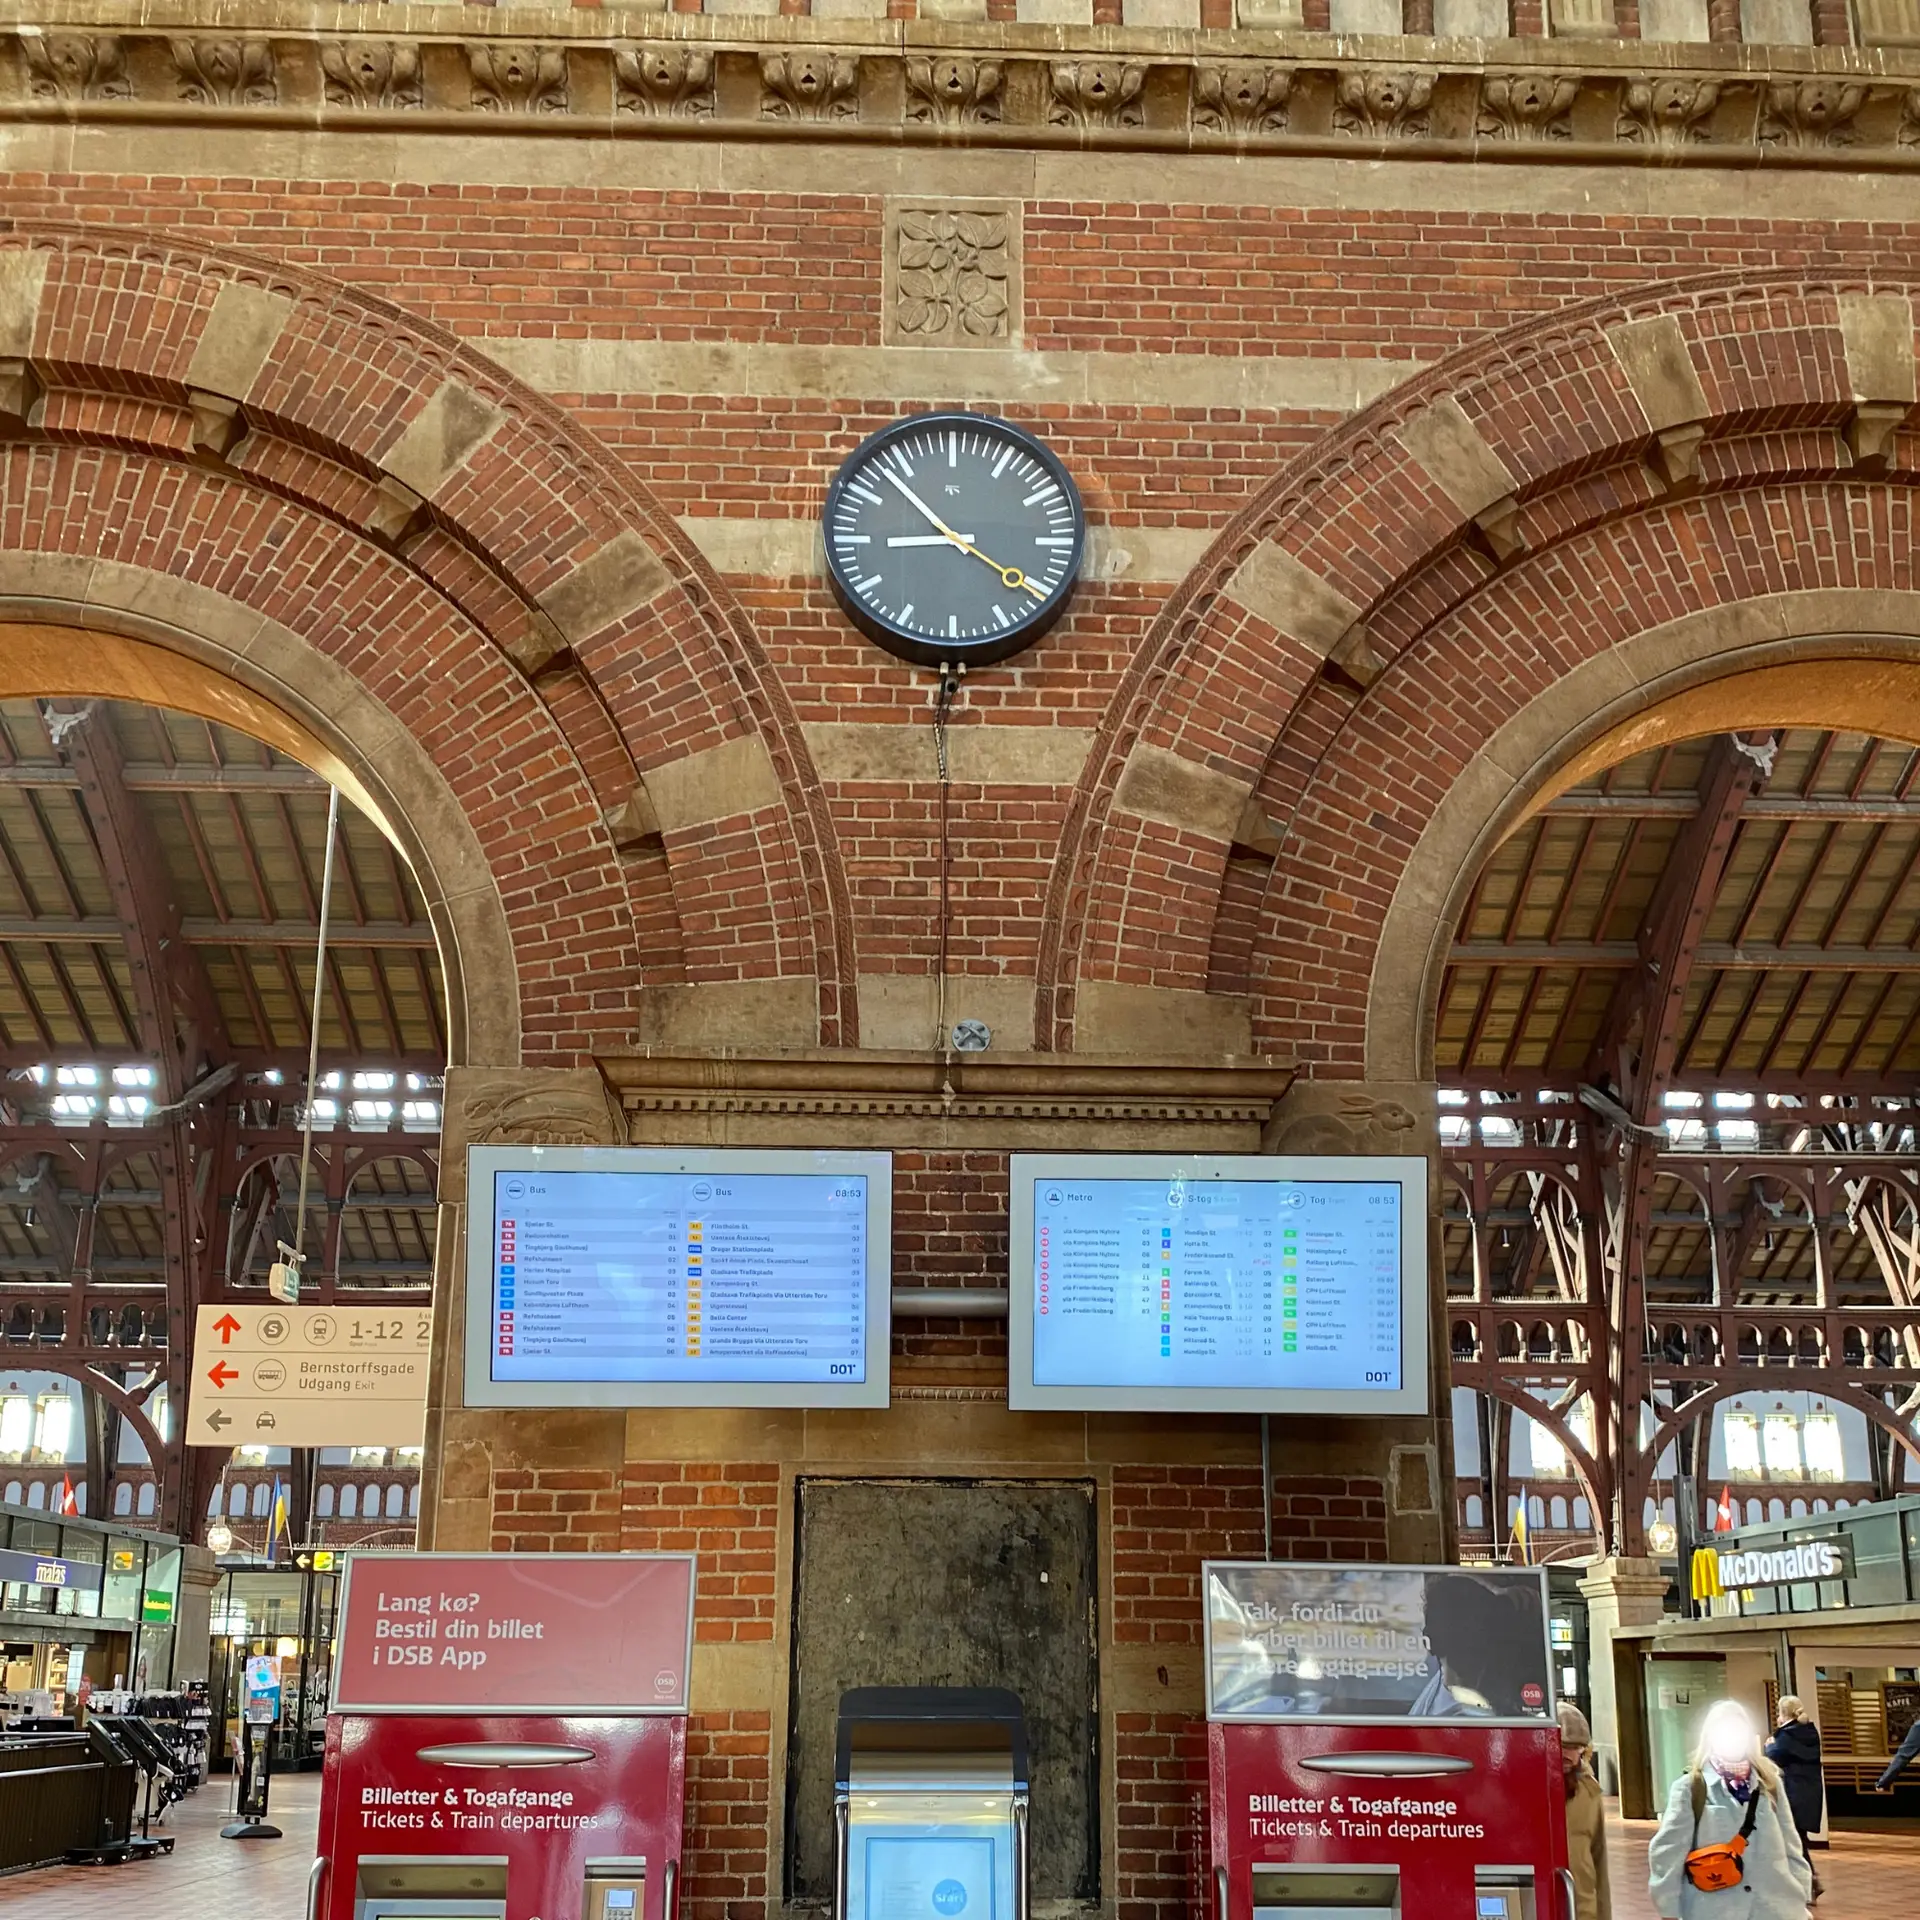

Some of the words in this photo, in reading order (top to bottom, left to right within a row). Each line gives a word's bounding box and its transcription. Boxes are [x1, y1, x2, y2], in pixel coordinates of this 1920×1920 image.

[716, 1188, 732, 1196] Bus
[835, 1189, 862, 1198] 08:53
[1188, 1195, 1211, 1204] S-tog
[1310, 1196, 1325, 1205] Tog
[350, 1320, 403, 1339] 1-12
[300, 1362, 415, 1376] Bernstorffsgade
[830, 1364, 856, 1374] DOT
[1365, 1372, 1391, 1382] DOT
[299, 1378, 350, 1392] Udgang
[355, 1380, 375, 1390] Exit
[35, 1561, 66, 1586] matas
[1718, 1541, 1839, 1588] McDonald's
[377, 1592, 432, 1616] Lang
[438, 1592, 480, 1613] kø?
[1240, 1602, 1285, 1624] Tak,
[1290, 1602, 1343, 1622] fordi
[1352, 1604, 1379, 1623] du
[375, 1618, 437, 1639] Bestil
[444, 1618, 480, 1639] din
[487, 1619, 545, 1640] billet
[1313, 1630, 1367, 1650] billet
[1375, 1630, 1396, 1650] til
[1404, 1634, 1431, 1650] en
[372, 1646, 379, 1666] i
[387, 1646, 434, 1666] DSB
[440, 1646, 487, 1670] App
[1376, 1658, 1429, 1680] rejse
[361, 1788, 439, 1806] Billetter
[444, 1788, 458, 1805] &
[463, 1788, 574, 1809] Togafgange
[1249, 1795, 1324, 1814] Billetter
[1330, 1797, 1345, 1814] &
[1348, 1797, 1457, 1818] Togafgange
[360, 1811, 424, 1828] Tickets
[431, 1812, 444, 1828] &
[450, 1812, 494, 1829] Train
[501, 1812, 599, 1832] departures
[1250, 1818, 1313, 1837] Tickets
[1320, 1820, 1333, 1837] &
[1338, 1820, 1381, 1837] Train
[1388, 1820, 1484, 1841] departures
